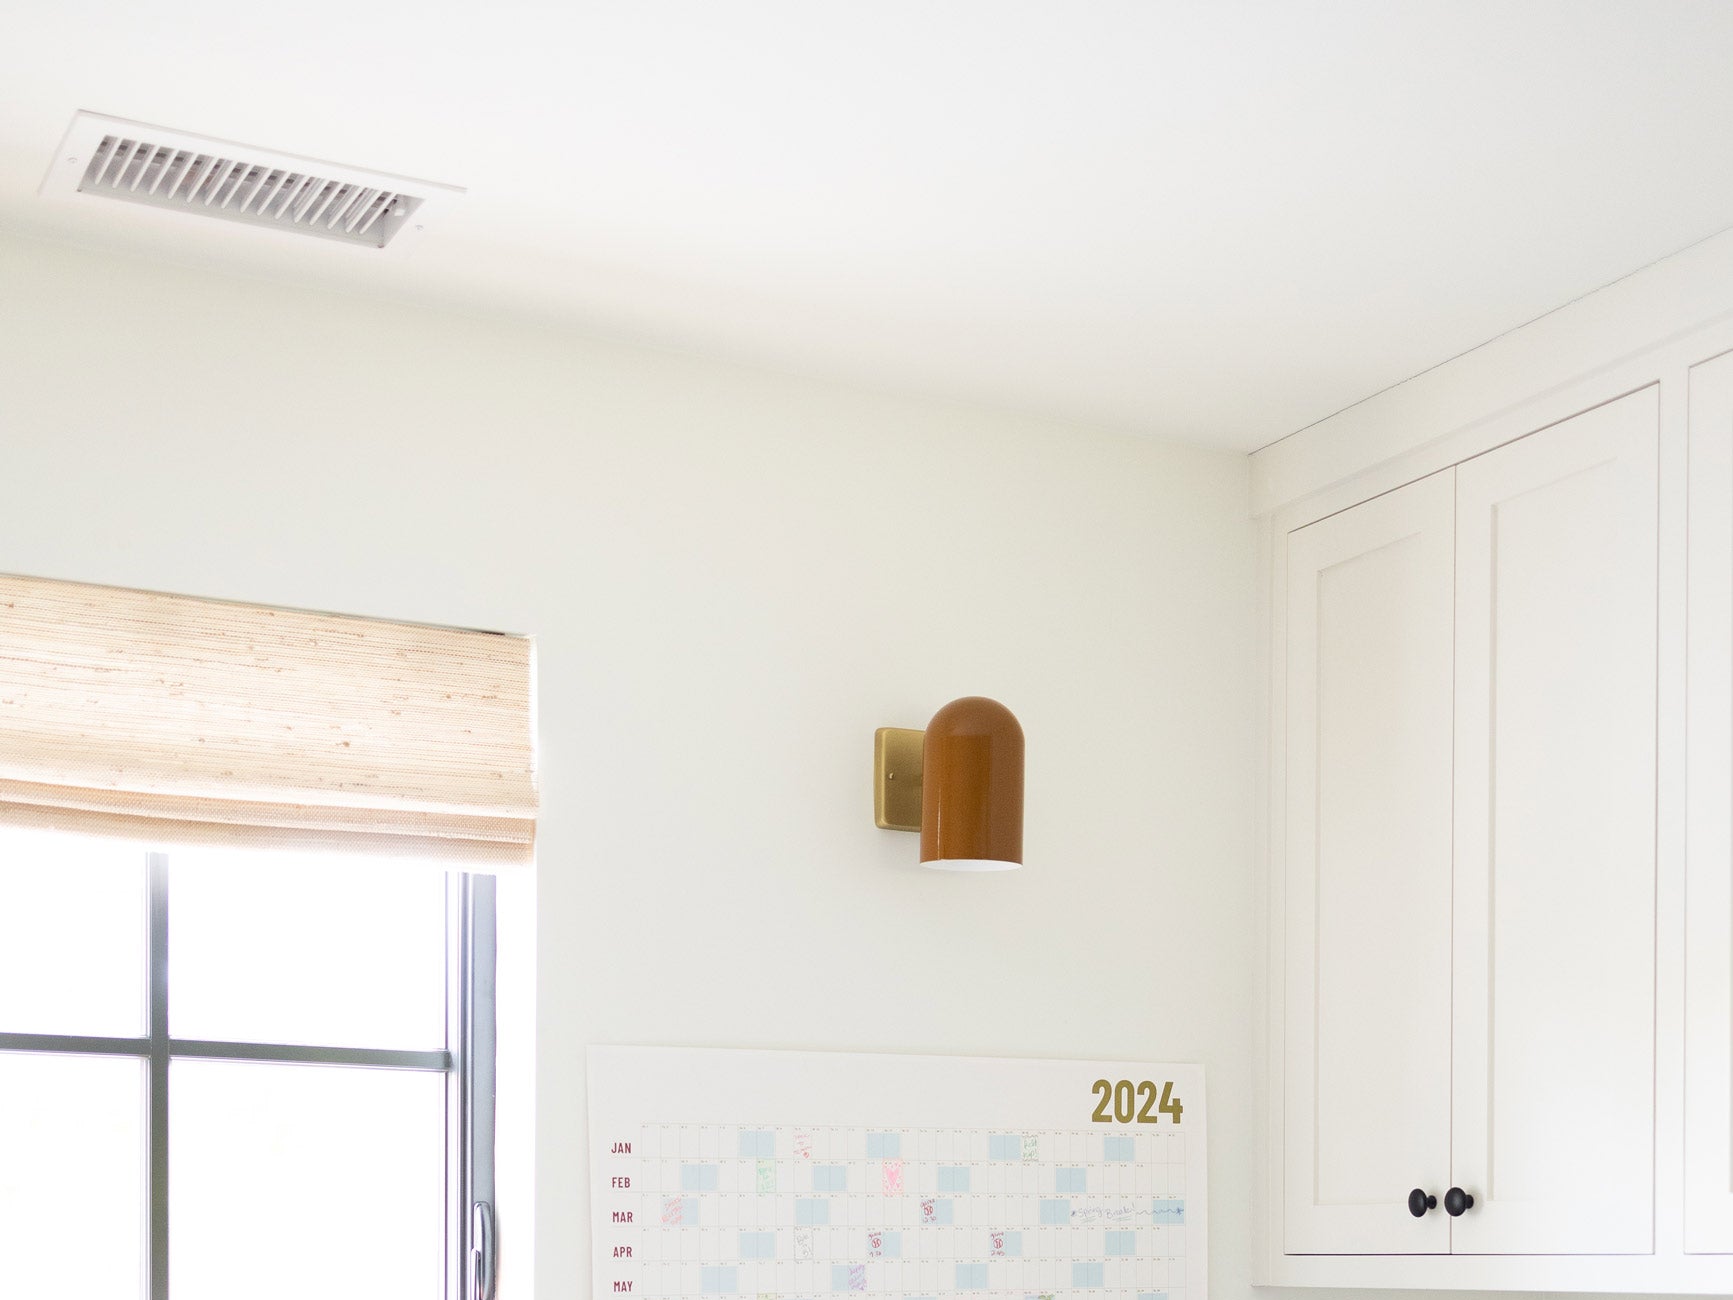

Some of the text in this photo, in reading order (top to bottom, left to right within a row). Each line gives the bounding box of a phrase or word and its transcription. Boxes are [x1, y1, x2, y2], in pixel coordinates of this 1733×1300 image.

[1091, 1078, 1184, 1125] 2024
[611, 1142, 632, 1154] JAN
[611, 1177, 631, 1188] FEB
[612, 1211, 633, 1223] MAR
[613, 1246, 633, 1258] APR
[613, 1281, 633, 1293] MAY
